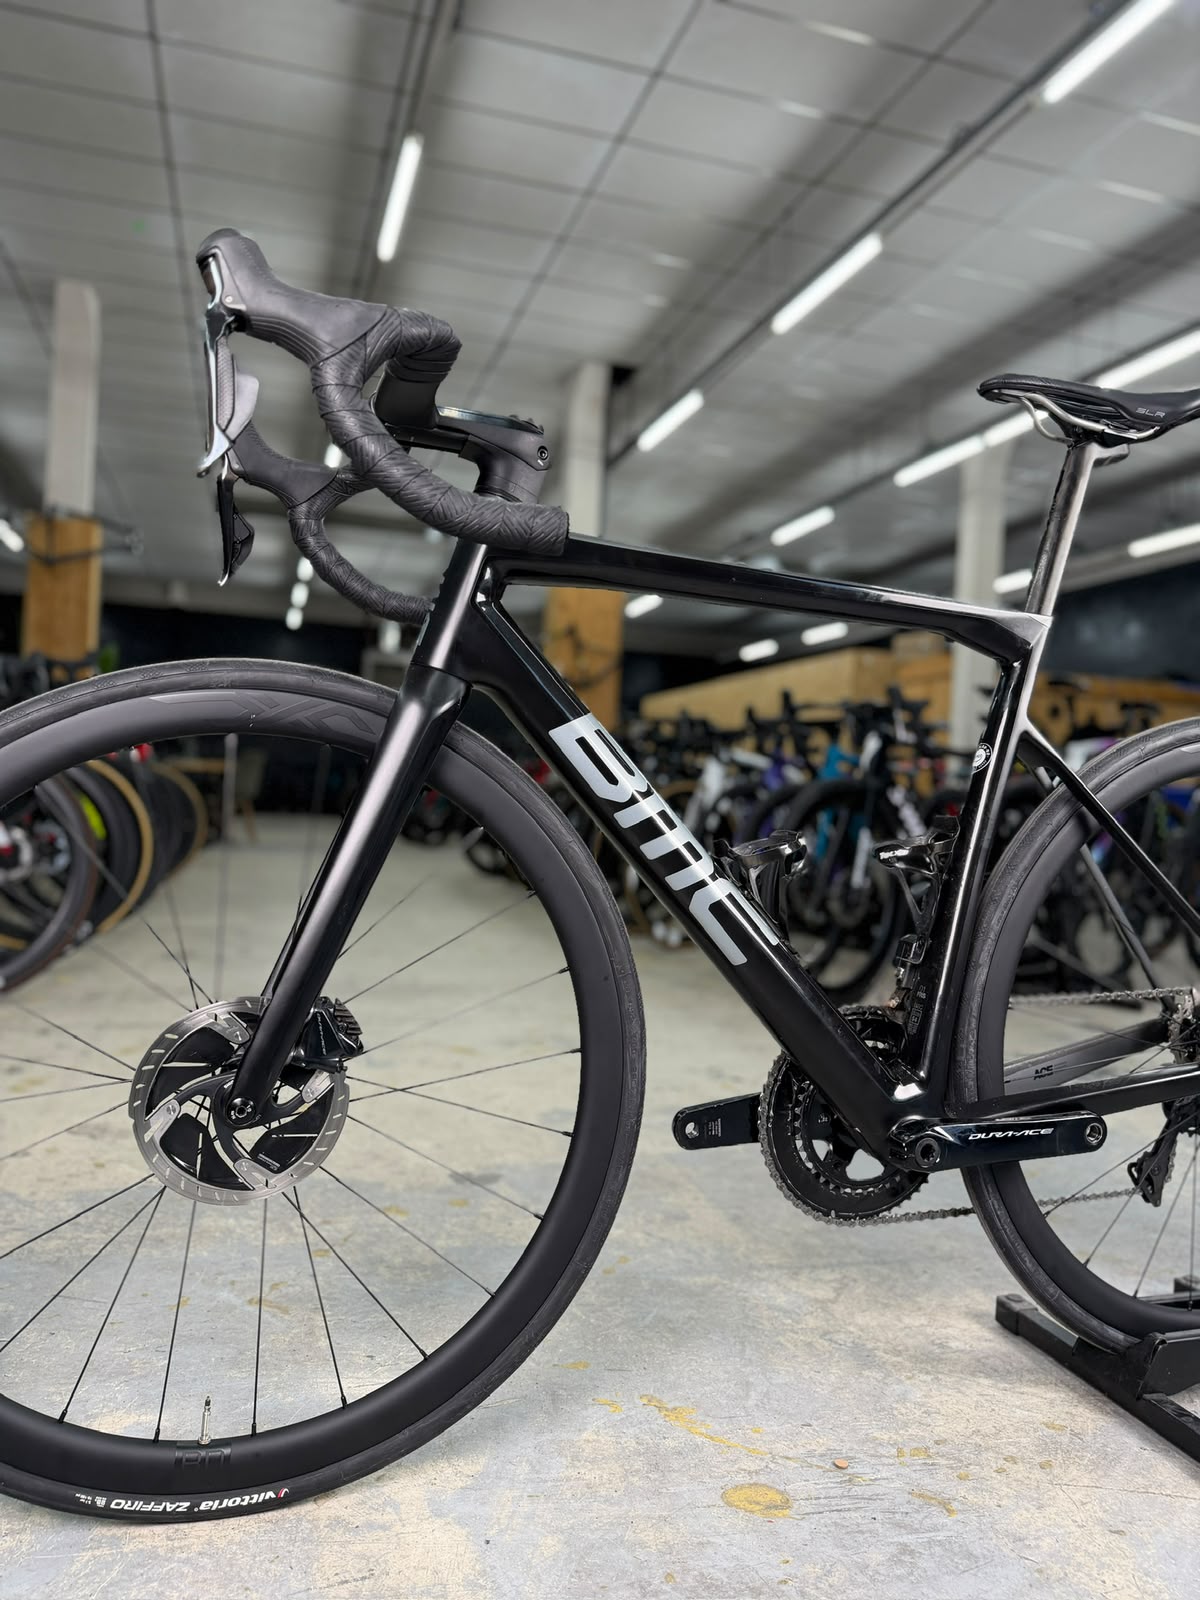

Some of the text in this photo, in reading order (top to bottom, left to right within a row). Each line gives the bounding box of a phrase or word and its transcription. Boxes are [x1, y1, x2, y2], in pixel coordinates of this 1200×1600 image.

[1135, 407, 1166, 418] SLR
[968, 1127, 1055, 1140] DURA-ACE
[110, 1499, 191, 1512] ZAFFIRO
